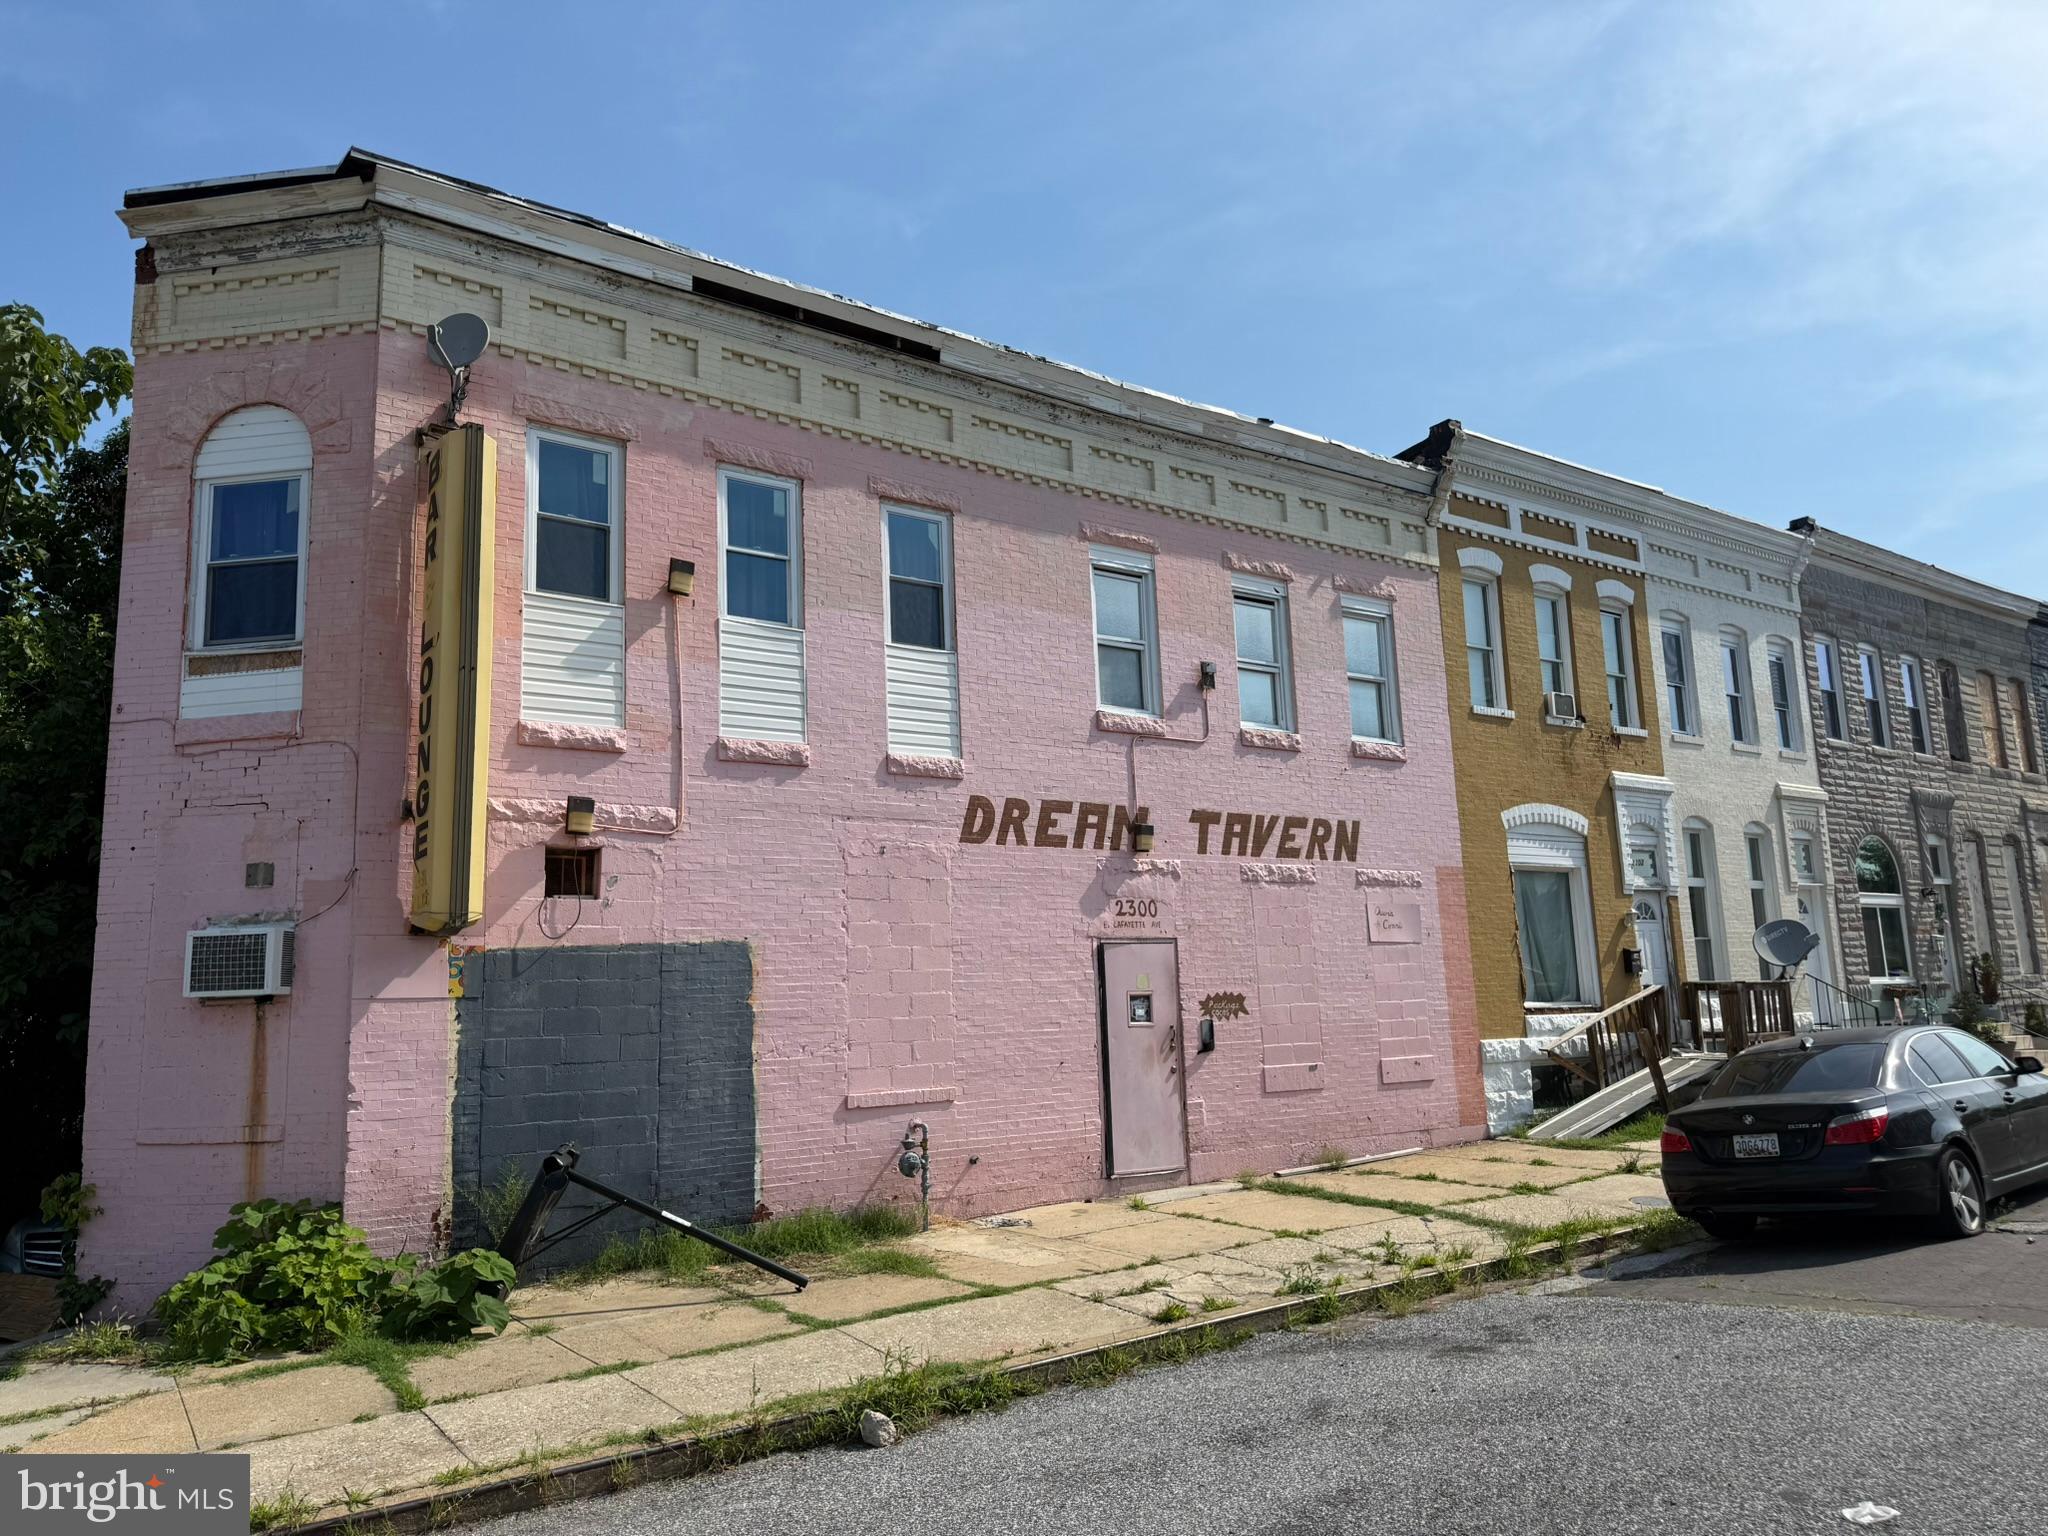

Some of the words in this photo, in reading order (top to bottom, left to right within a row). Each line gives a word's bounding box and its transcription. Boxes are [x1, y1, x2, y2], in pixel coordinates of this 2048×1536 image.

[425, 448, 441, 571] BAR
[415, 620, 438, 861] LOUNGE
[958, 794, 1149, 852] DREAM
[1189, 808, 1361, 863] TAVERN
[1113, 920, 1146, 929] LAFAYETTE
[1115, 899, 1157, 918] 2300
